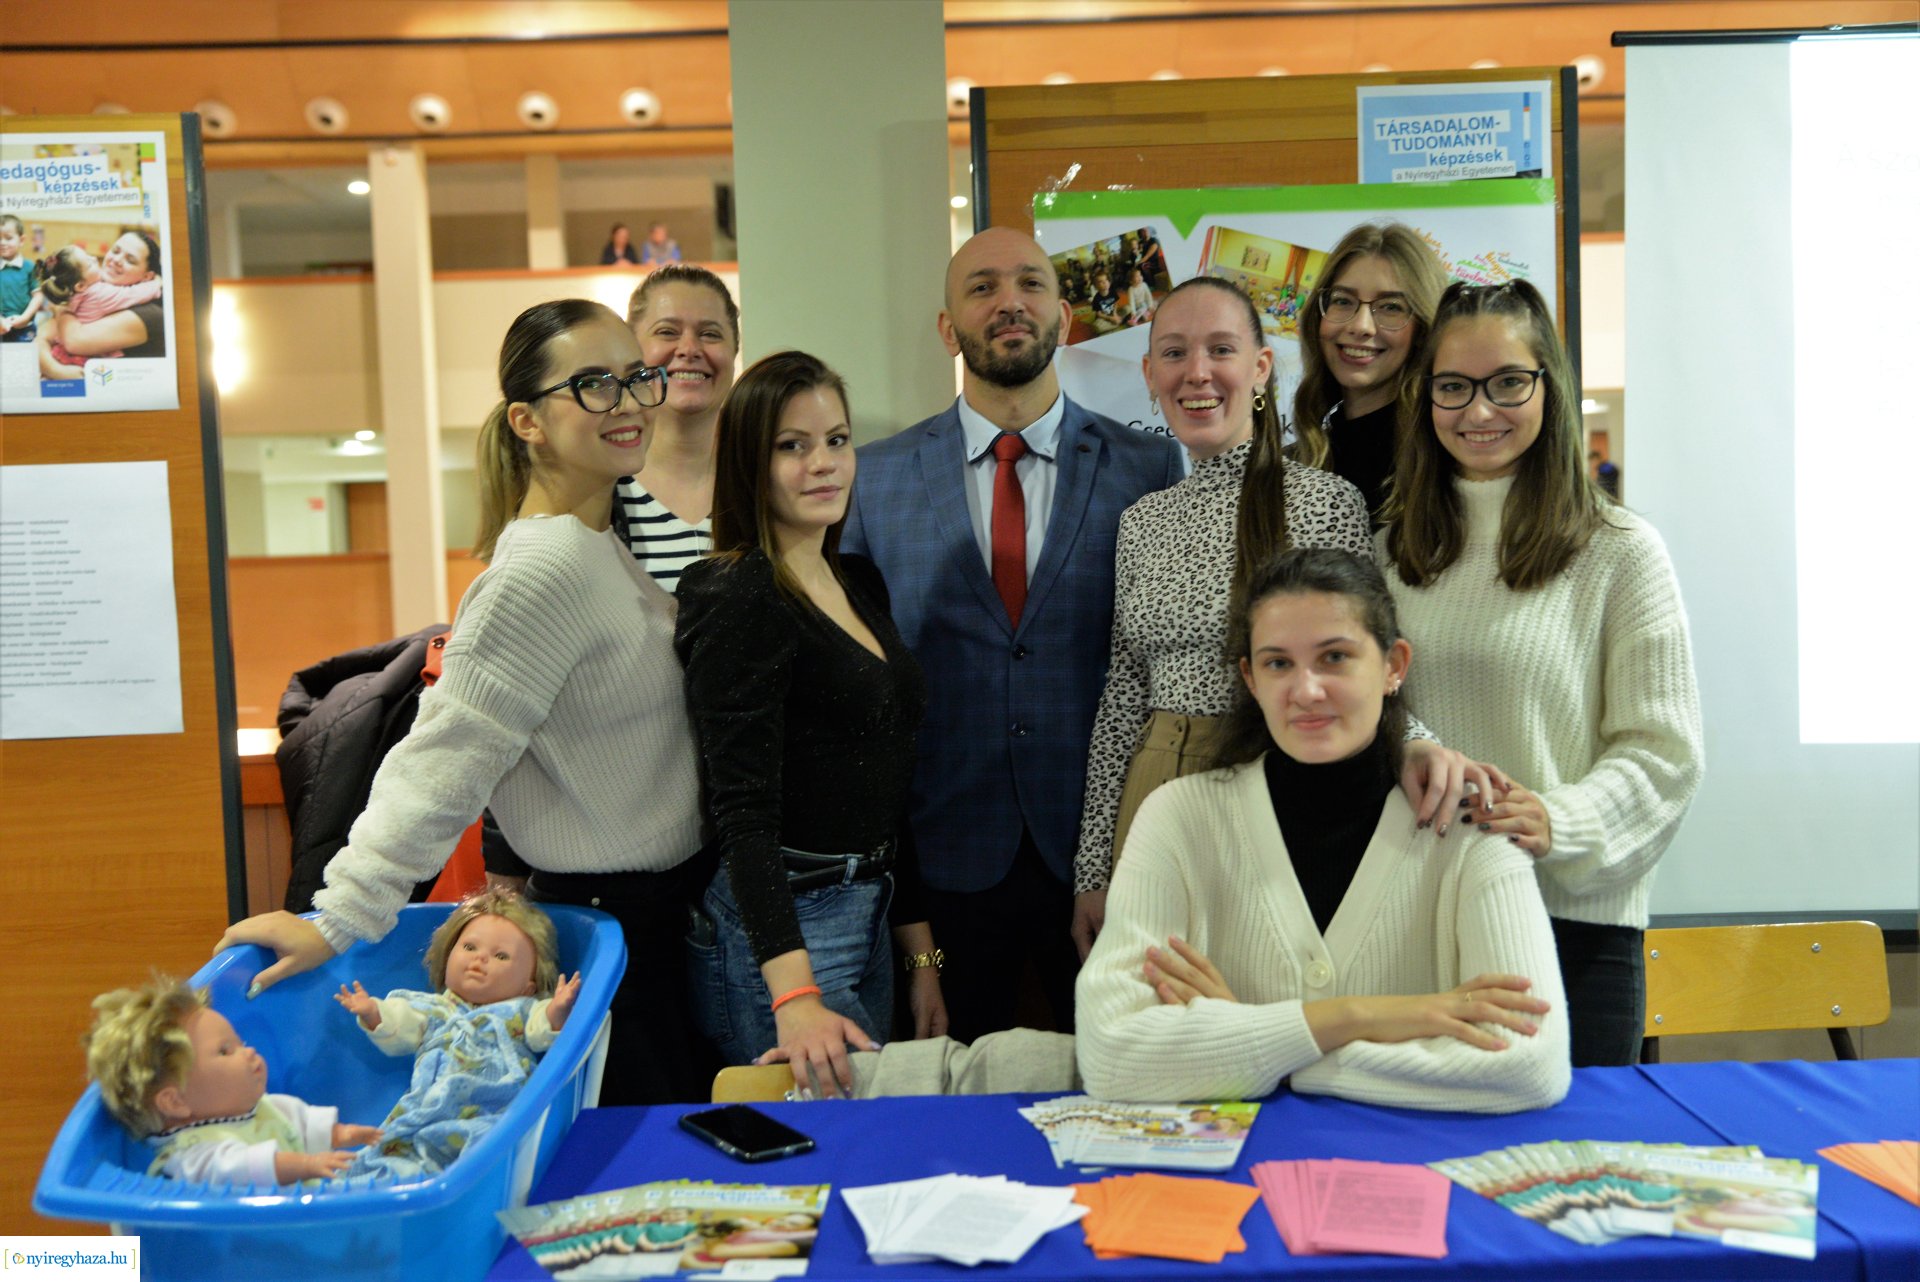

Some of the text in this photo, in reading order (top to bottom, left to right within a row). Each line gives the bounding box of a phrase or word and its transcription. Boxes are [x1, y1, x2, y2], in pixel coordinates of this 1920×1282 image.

[1376, 116, 1501, 137] TÁRSADALOM-
[1391, 130, 1492, 152] TUDOMÁNYI
[1429, 149, 1504, 167] képzések
[1462, 165, 1515, 178] Egyetemen
[43, 177, 119, 195] képzések
[75, 192, 139, 206] Egyetemen
